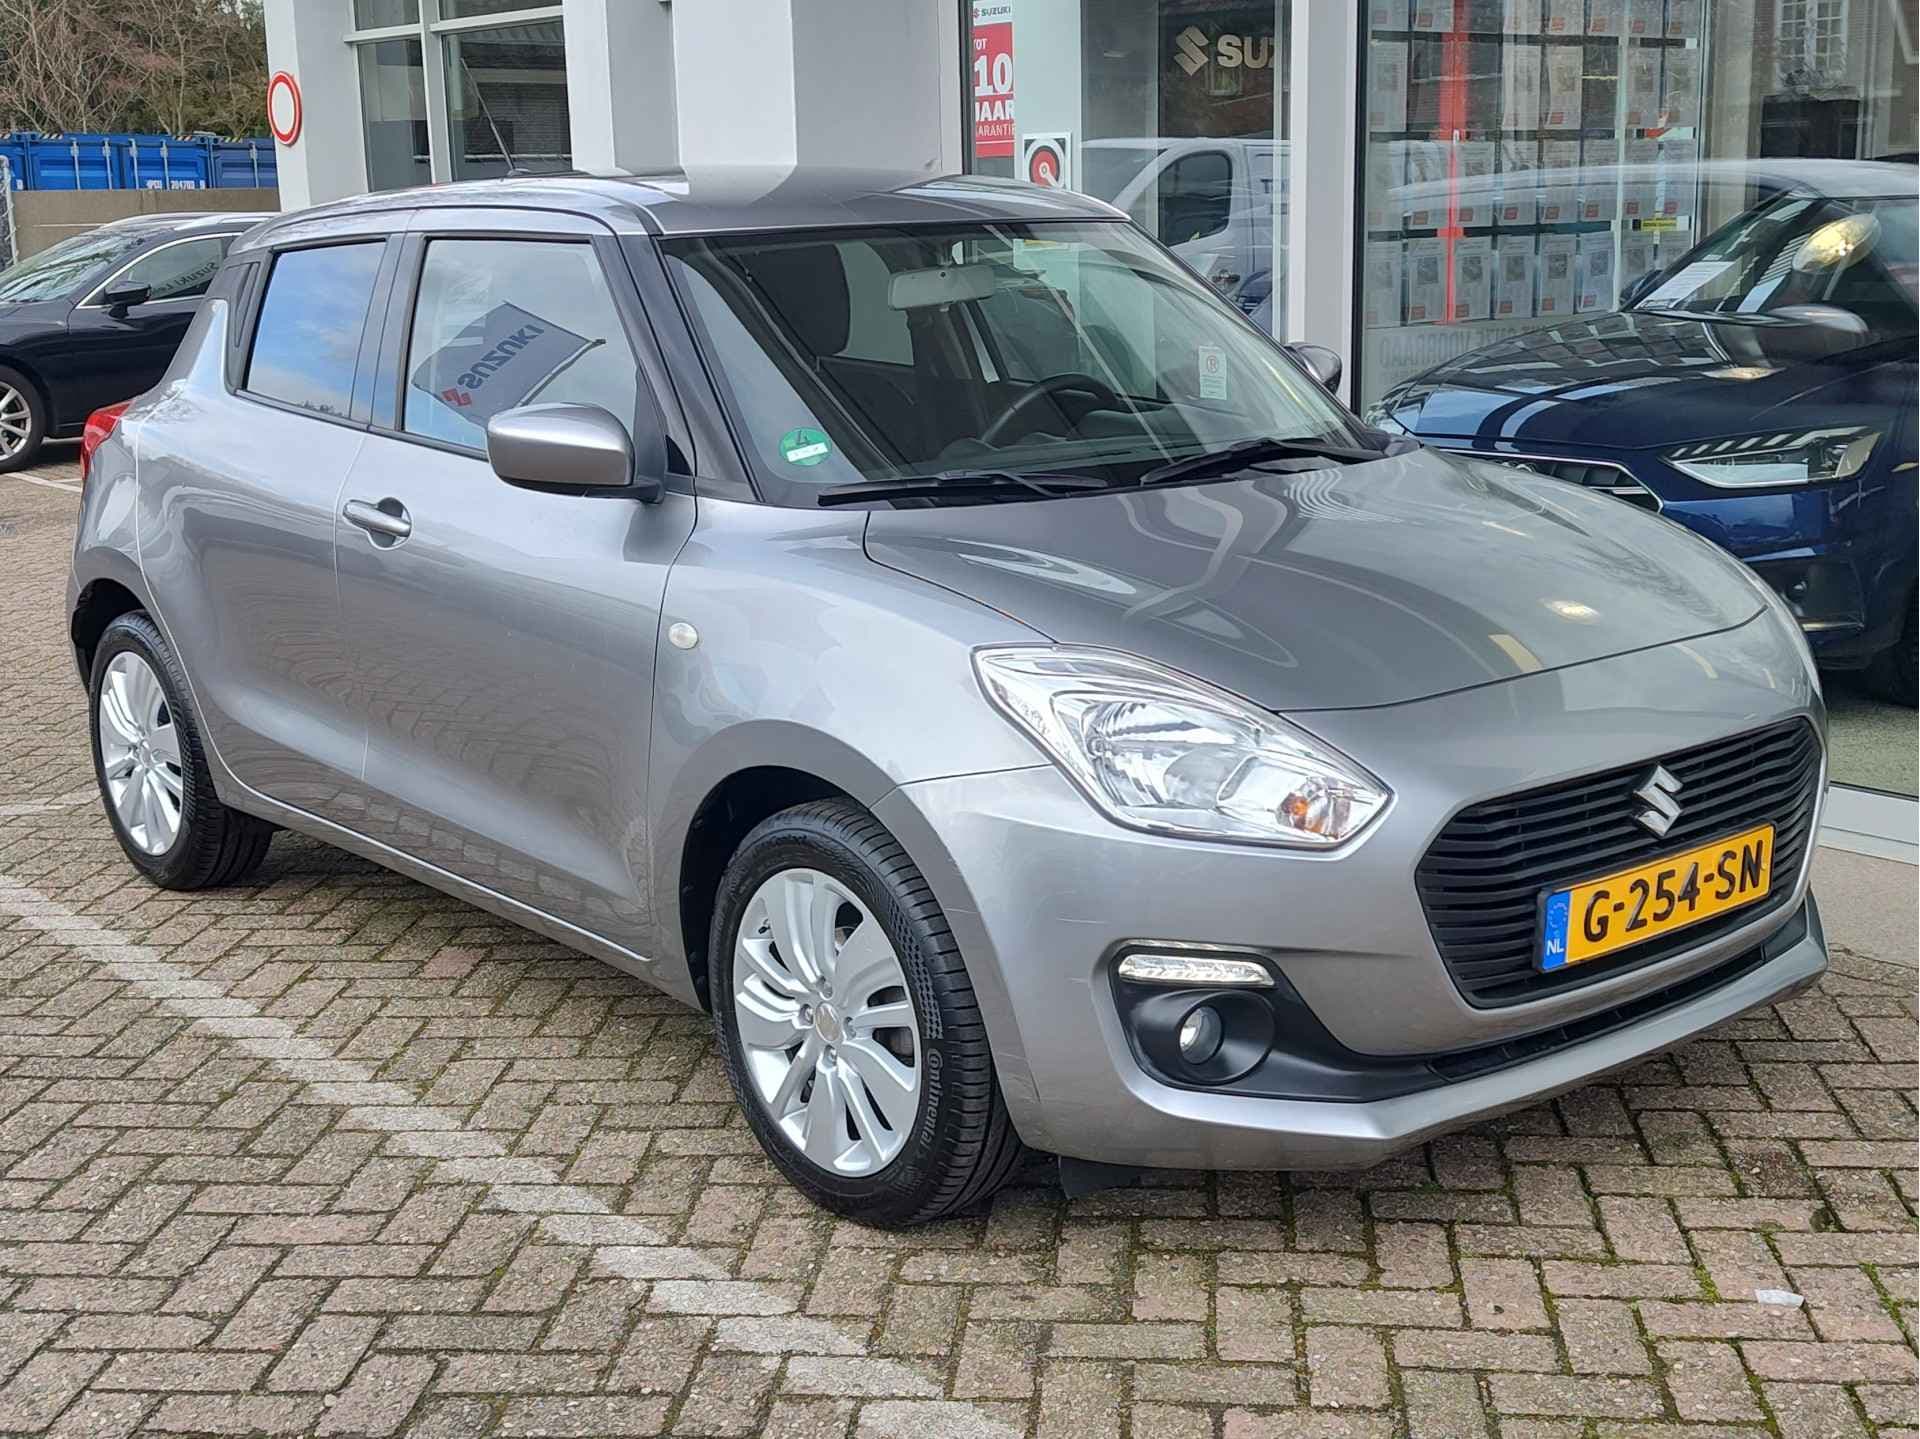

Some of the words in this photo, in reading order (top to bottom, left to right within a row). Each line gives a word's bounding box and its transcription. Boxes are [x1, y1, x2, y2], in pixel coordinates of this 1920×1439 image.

[981, 5, 1012, 18] SUZUKI
[974, 52, 1014, 96] 10
[975, 124, 1016, 138] ARANTIE
[1583, 839, 1765, 943] G-254-SN
[1546, 939, 1565, 954] NL
[919, 1048, 944, 1150] Continental
